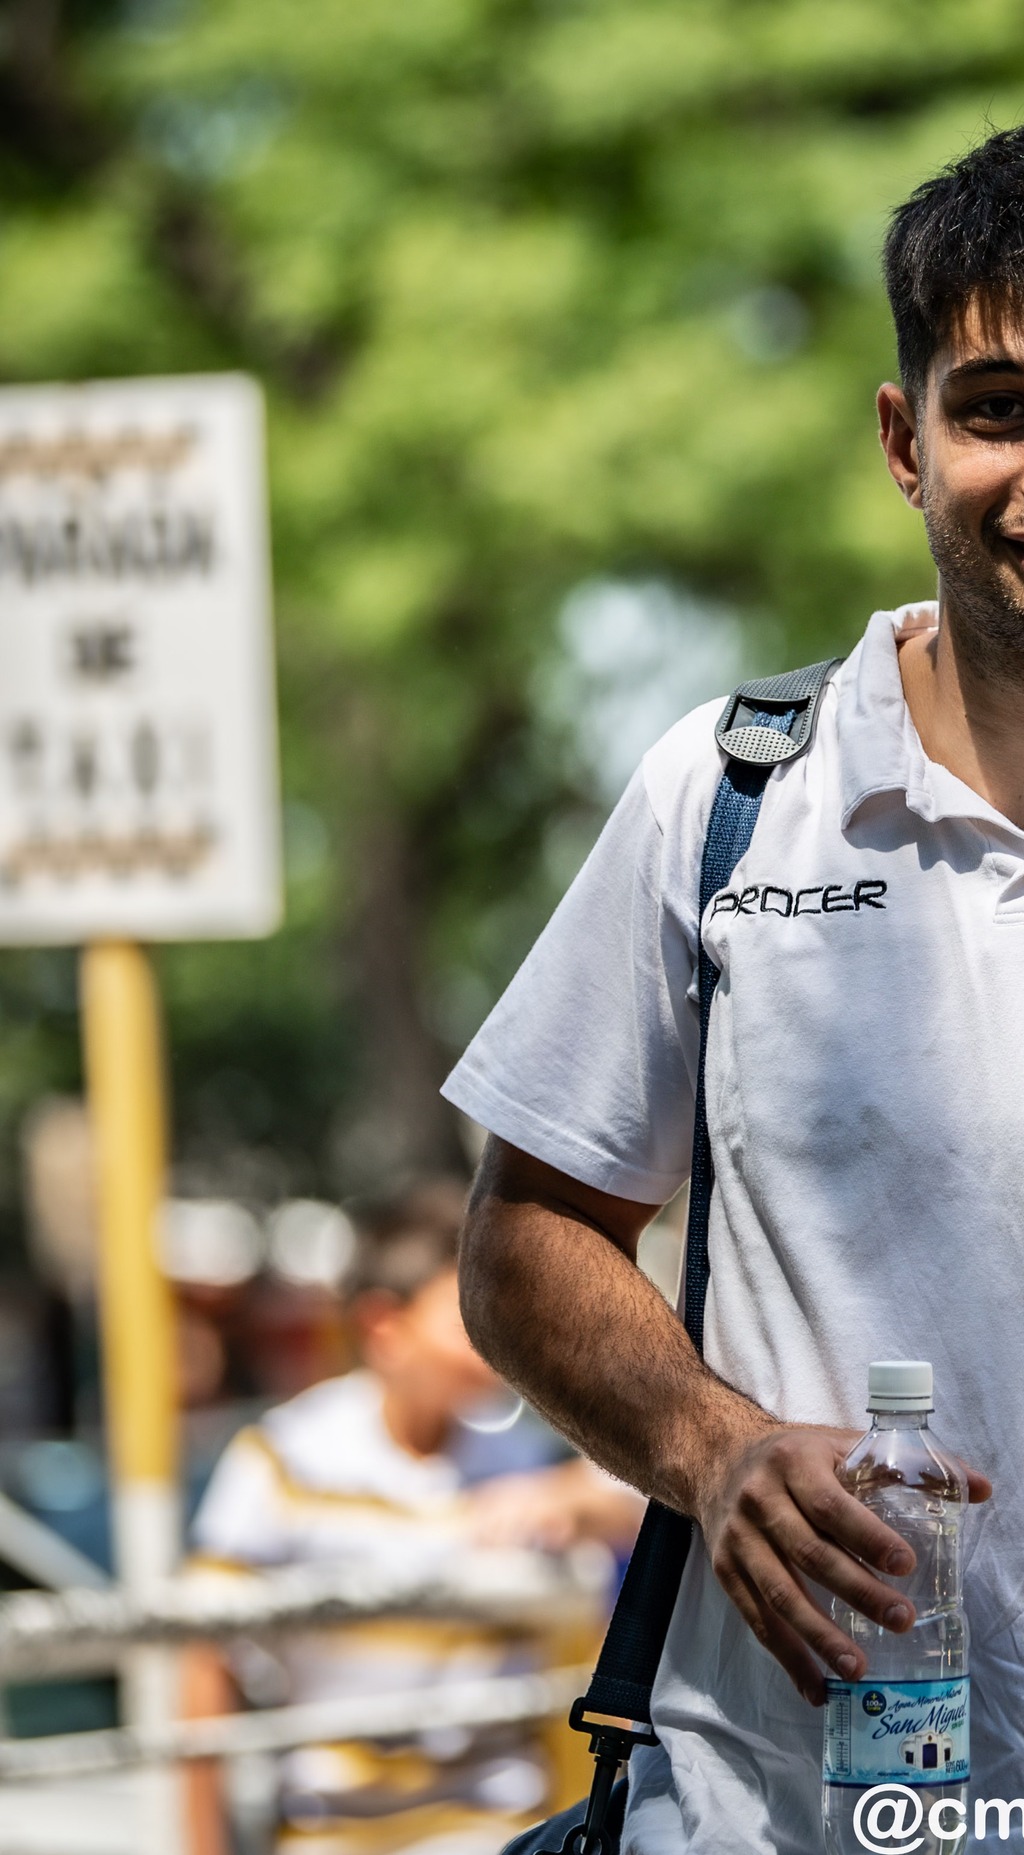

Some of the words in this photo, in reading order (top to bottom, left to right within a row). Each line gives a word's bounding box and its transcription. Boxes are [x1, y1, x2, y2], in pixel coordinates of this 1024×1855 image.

[708, 880, 887, 925] PROCER
[872, 1713, 920, 1740] San
[918, 1694, 967, 1734] Miguel
